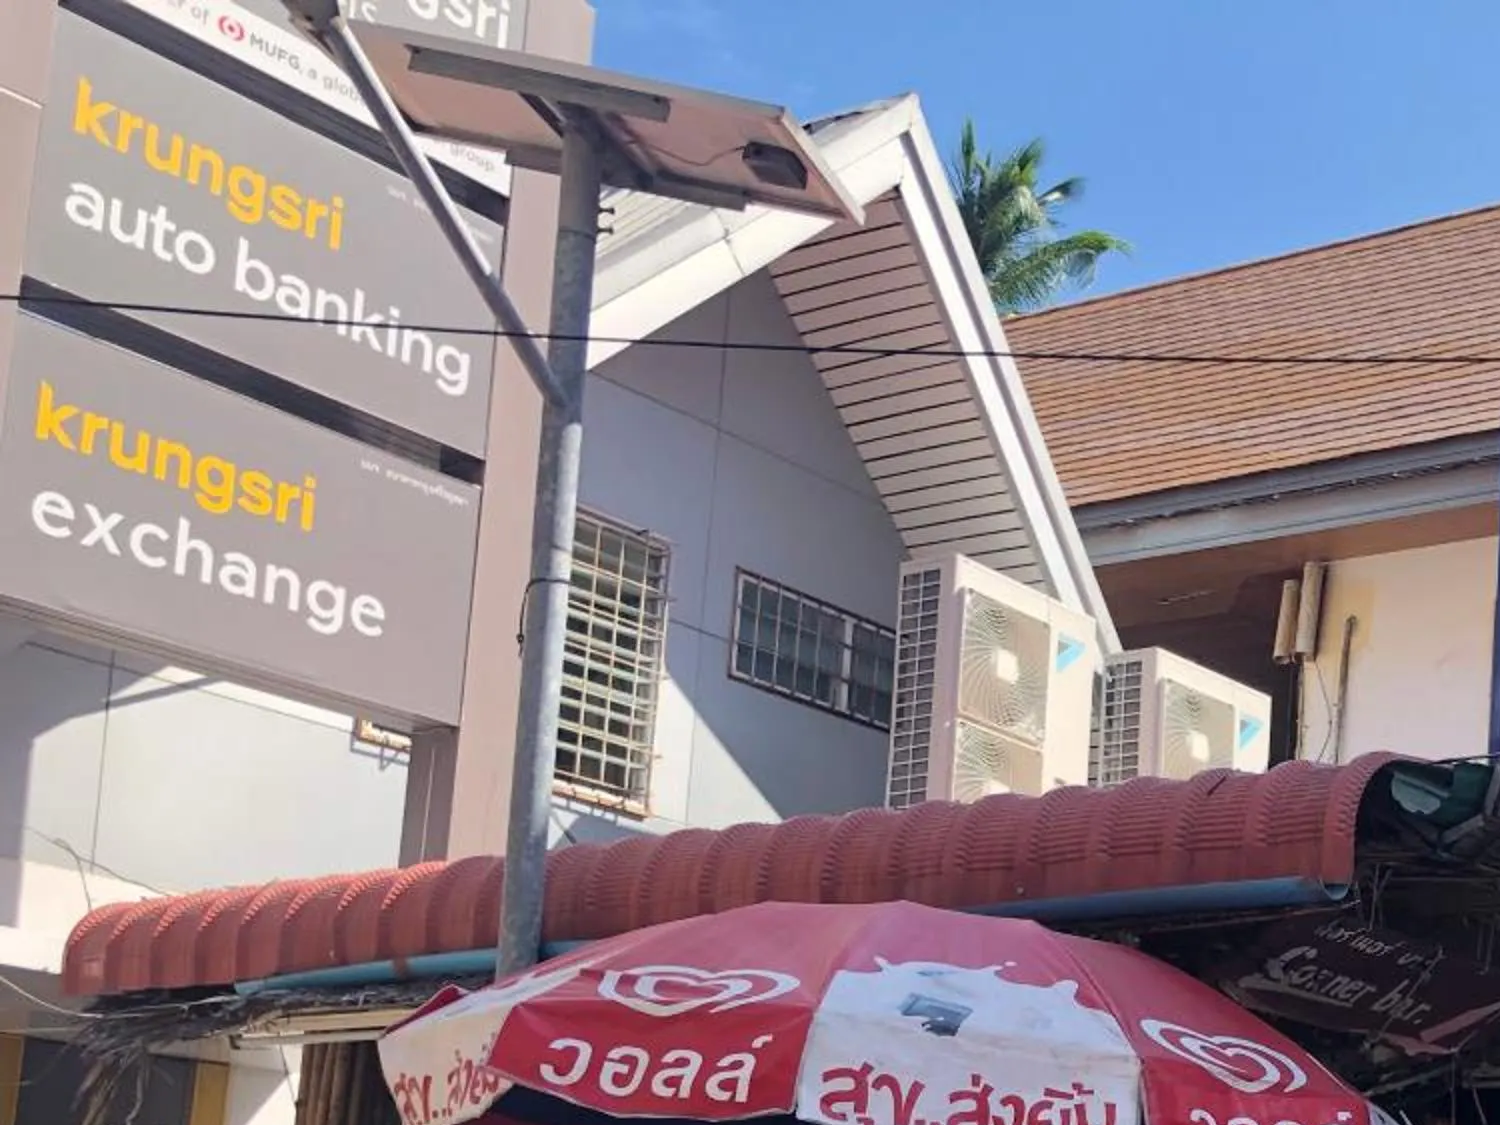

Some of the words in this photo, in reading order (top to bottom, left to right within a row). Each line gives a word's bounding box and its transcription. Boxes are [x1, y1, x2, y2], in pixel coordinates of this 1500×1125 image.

[74, 77, 344, 249] krungsri
[64, 182, 215, 274] auto
[234, 238, 470, 396] banking
[35, 380, 316, 531] krungsri
[31, 490, 386, 637] exchange
[540, 1034, 773, 1103] วอลล์
